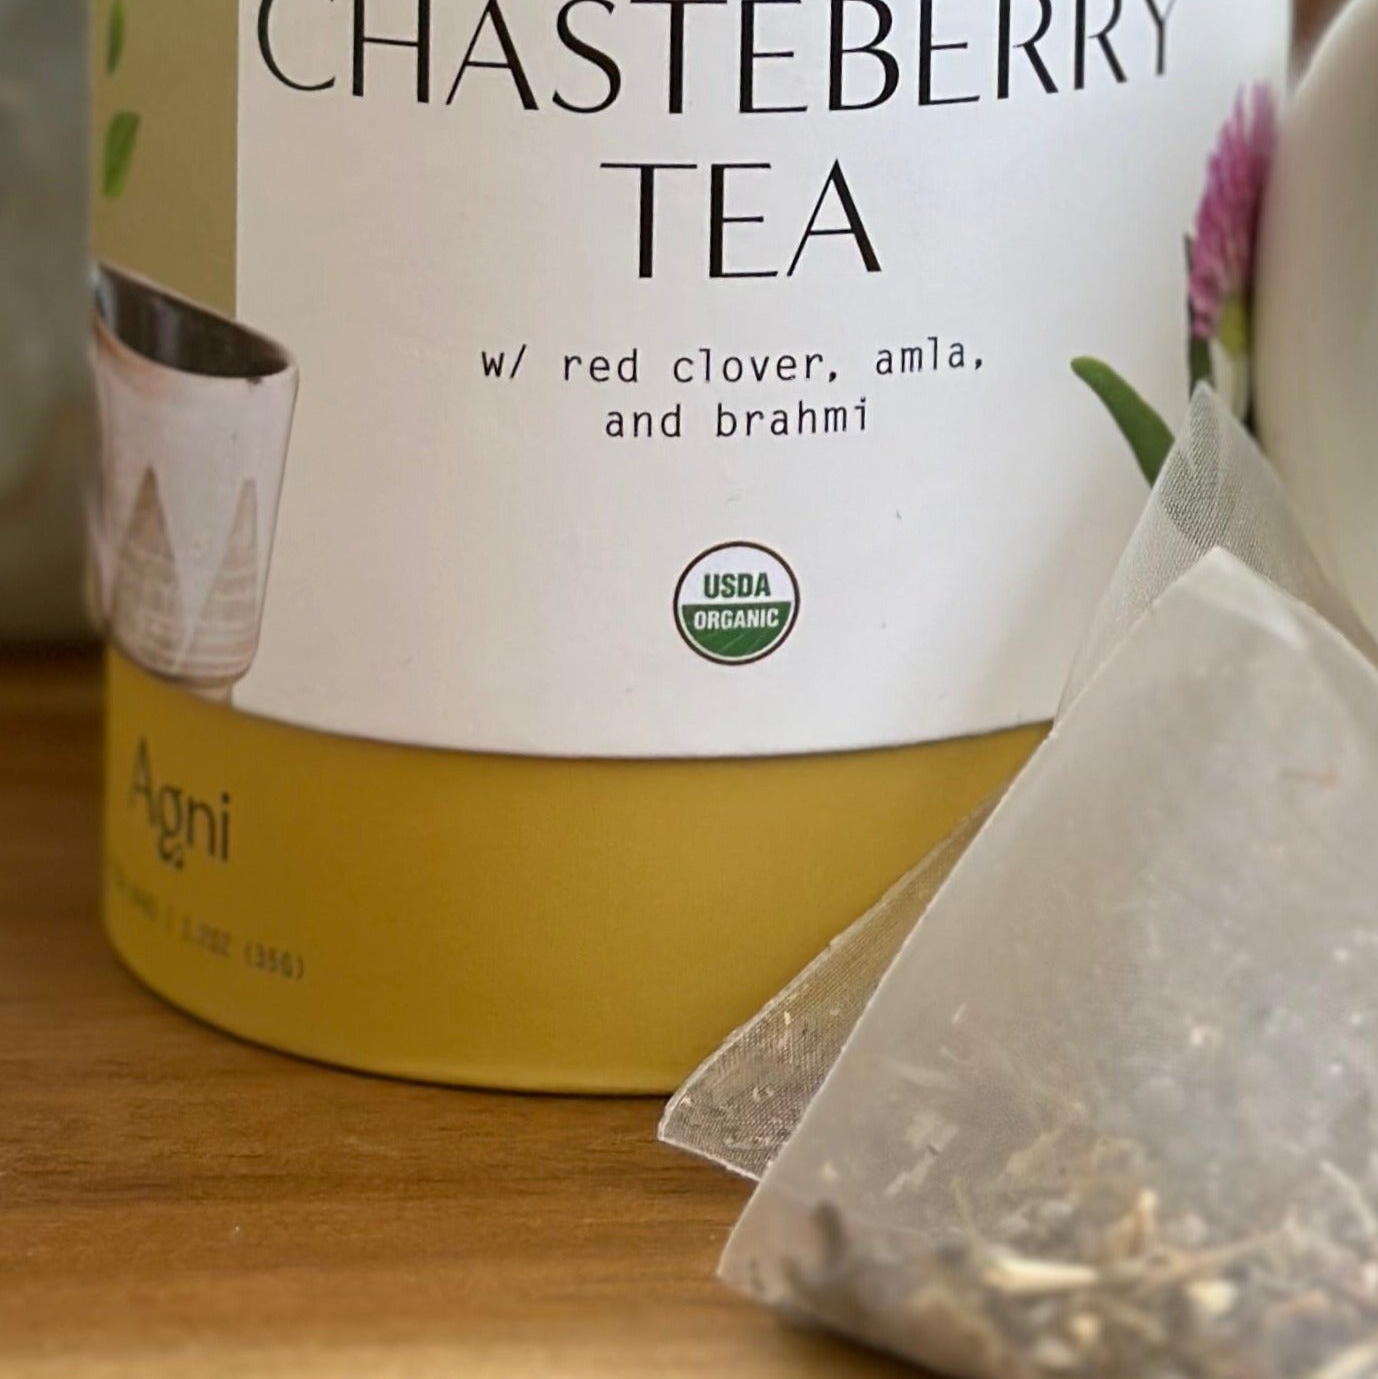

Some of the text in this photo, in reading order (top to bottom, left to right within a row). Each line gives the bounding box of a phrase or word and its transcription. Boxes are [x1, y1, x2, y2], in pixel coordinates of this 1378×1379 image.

[599, 157, 883, 280] TEA
[481, 335, 984, 384] w/ red clover, amla,
[605, 396, 867, 439] and brahmi
[703, 571, 771, 599] USDA
[694, 607, 779, 631] ORGANIC
[128, 734, 231, 870] Agni
